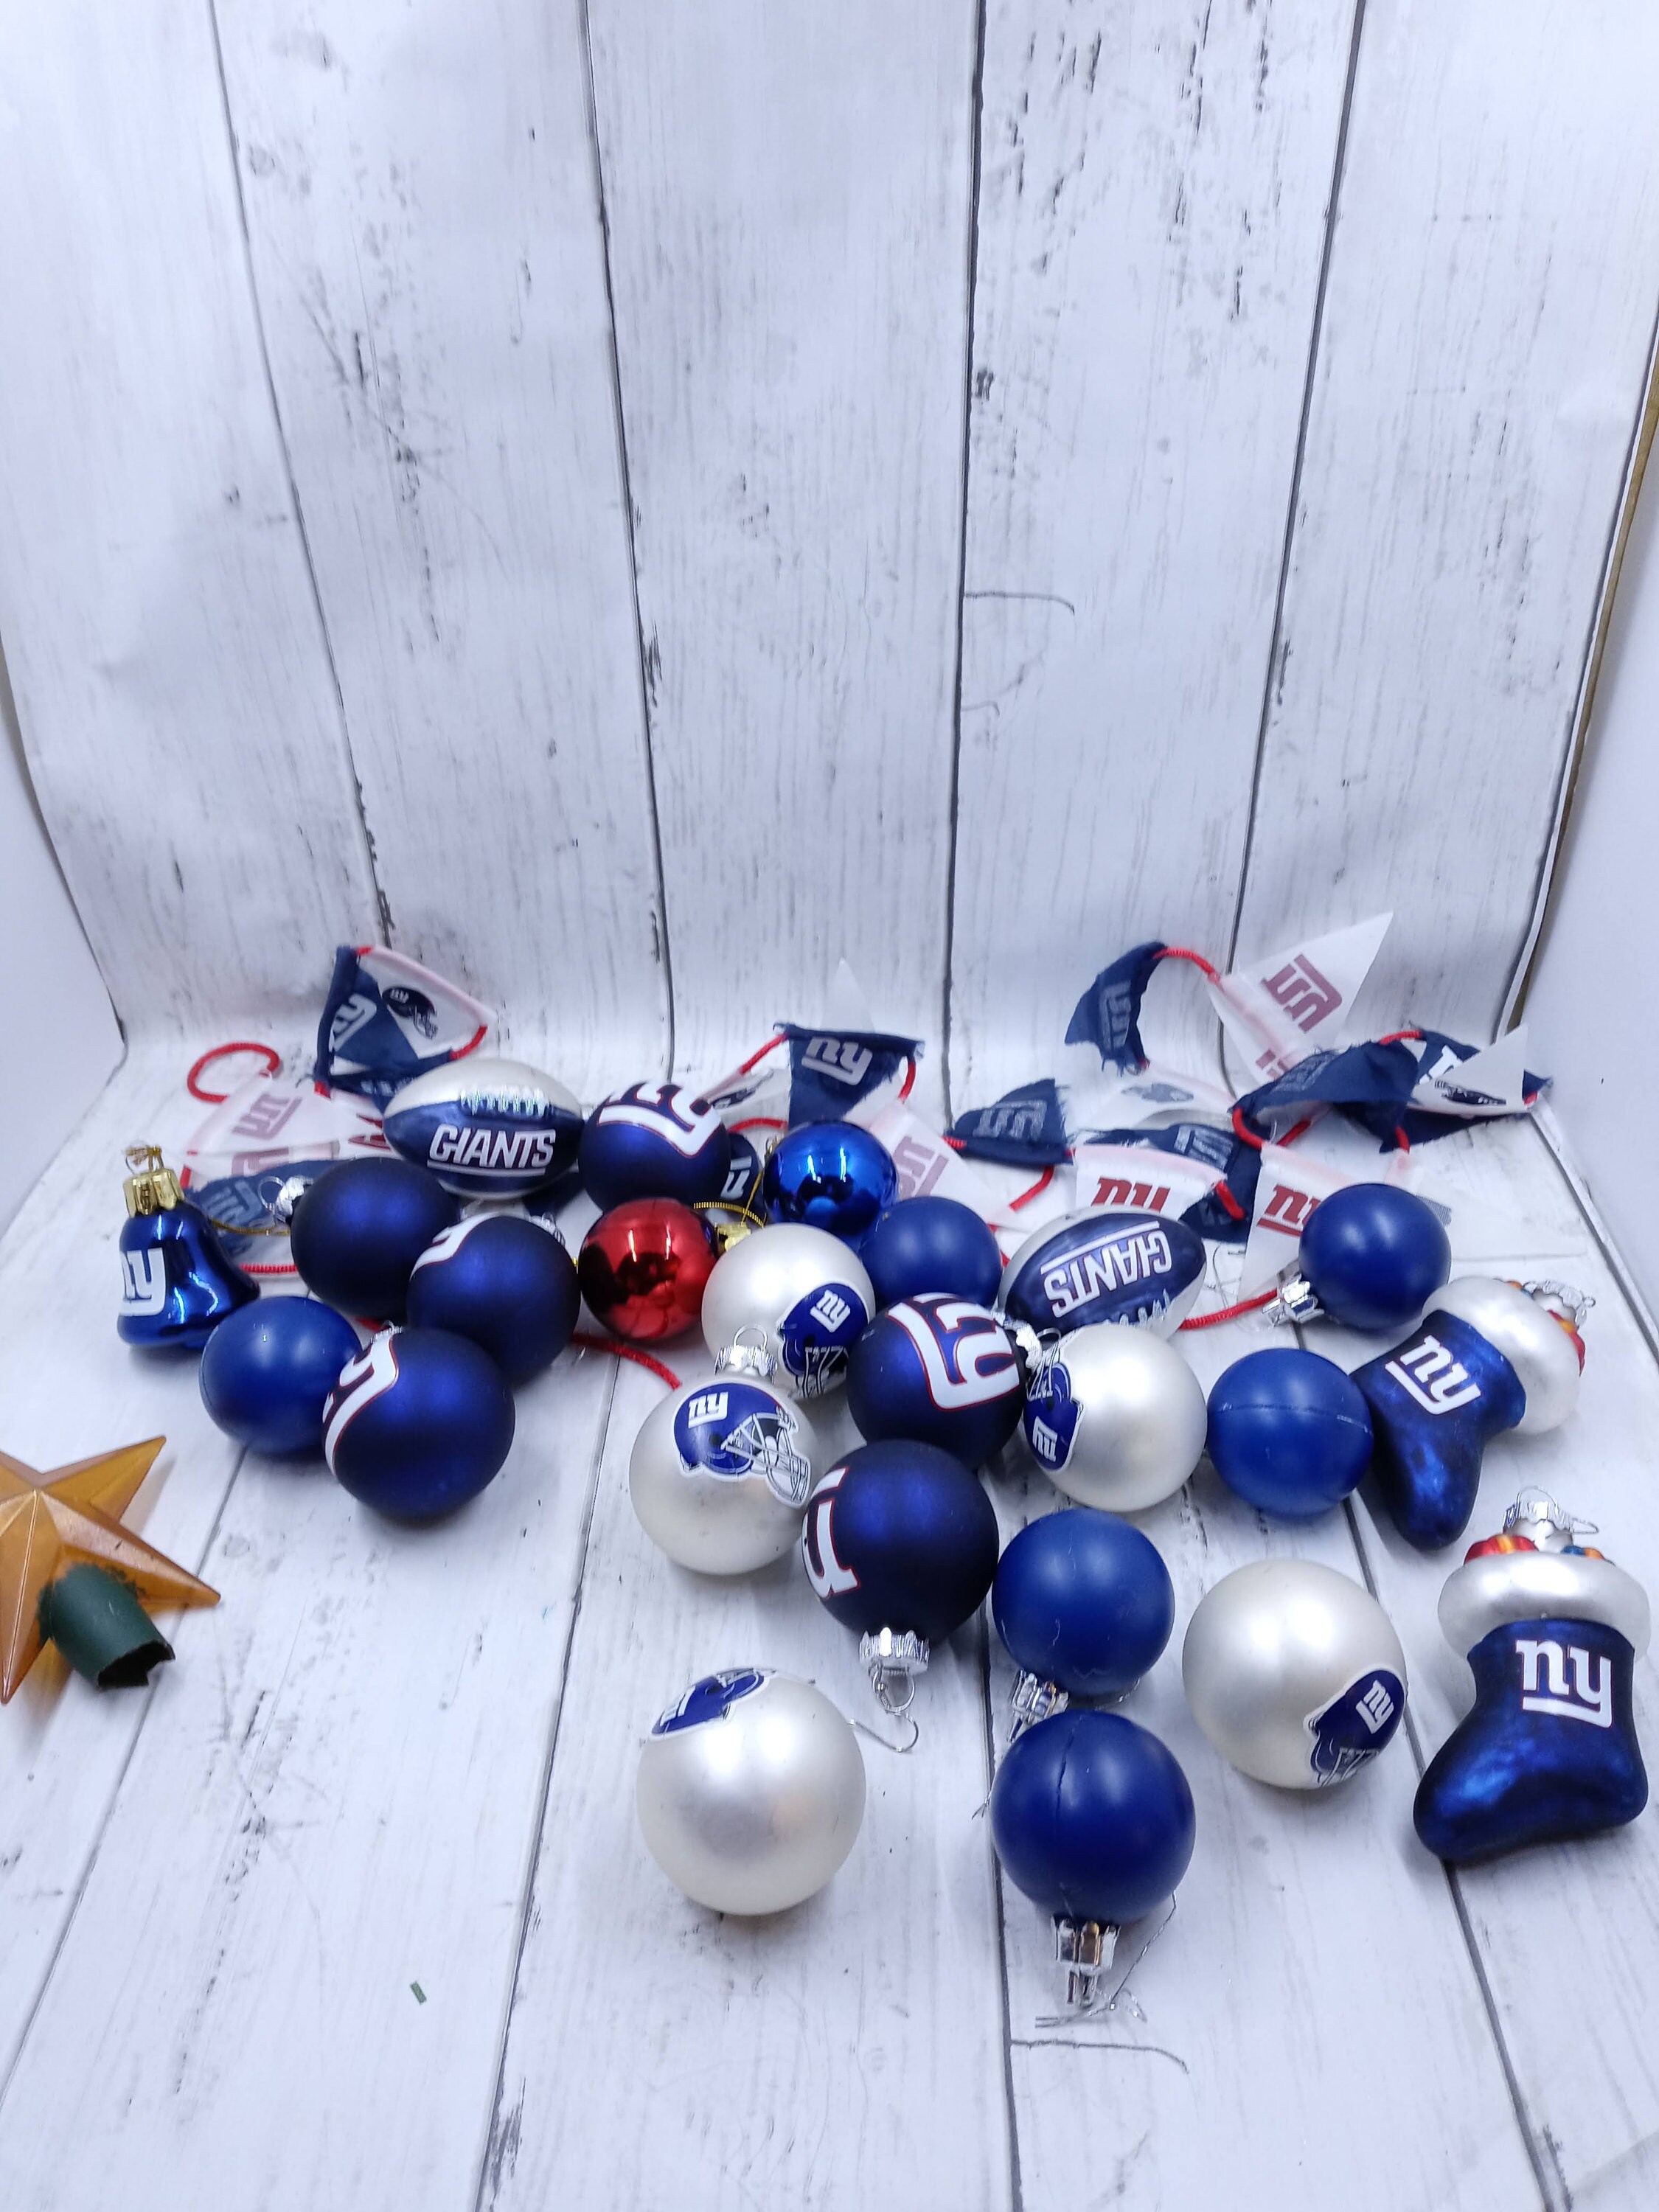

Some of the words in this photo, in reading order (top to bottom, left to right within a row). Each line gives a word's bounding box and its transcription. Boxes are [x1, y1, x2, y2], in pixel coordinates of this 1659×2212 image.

[801, 1037, 873, 1085] ny
[428, 1123, 557, 1171] GIANTS
[1043, 1229, 1172, 1318] GIANTS
[810, 1290, 851, 1333] ny
[1385, 1335, 1481, 1415] ny
[688, 1391, 728, 1429] ny
[1355, 1680, 1394, 1734] ny
[1515, 1639, 1613, 1728] ny
